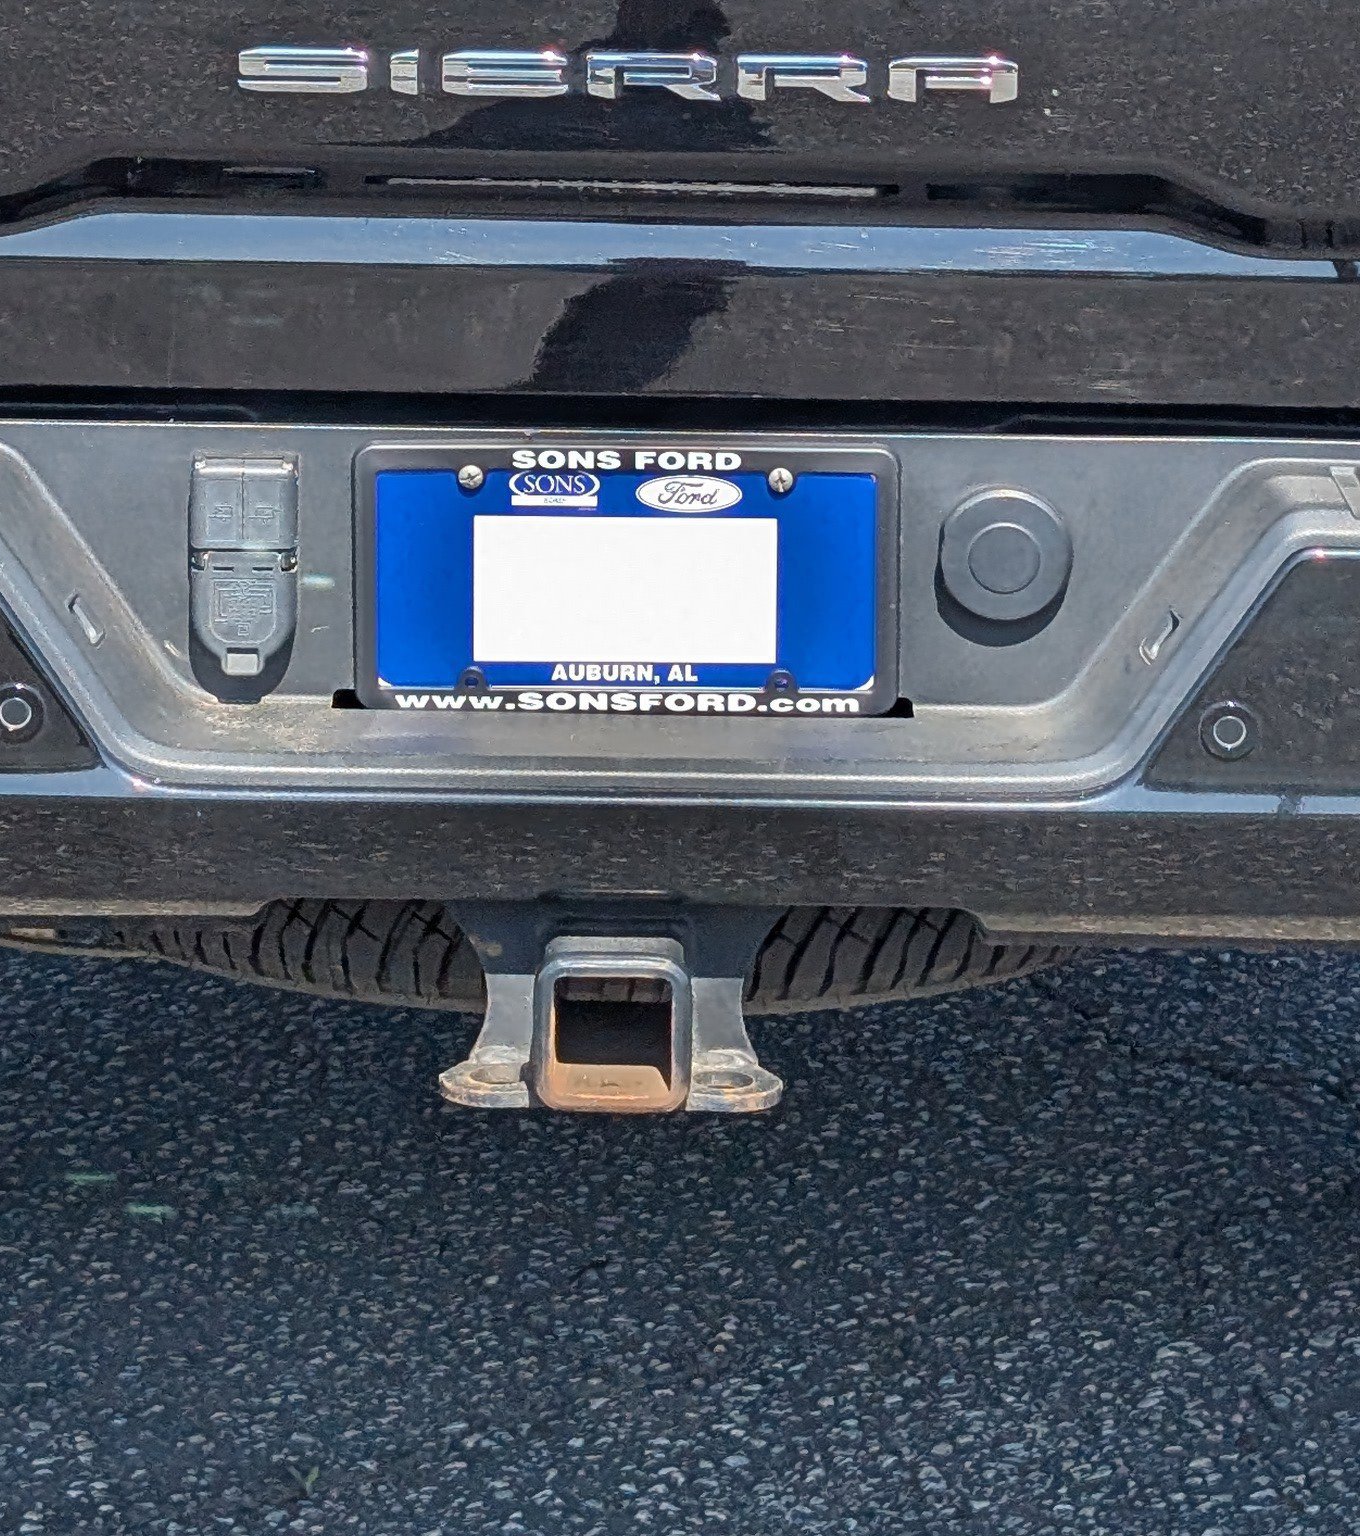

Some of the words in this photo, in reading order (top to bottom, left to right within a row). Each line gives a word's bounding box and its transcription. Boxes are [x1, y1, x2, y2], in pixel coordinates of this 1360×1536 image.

[237, 46, 1020, 104] SIERRA
[511, 449, 622, 471] SONS
[634, 451, 743, 472] FORD
[522, 473, 586, 494] SONS
[657, 480, 720, 505] Ford
[551, 663, 661, 686] AUBURN,
[667, 664, 699, 682] AL
[395, 691, 861, 714] www.SONSFORD.com
